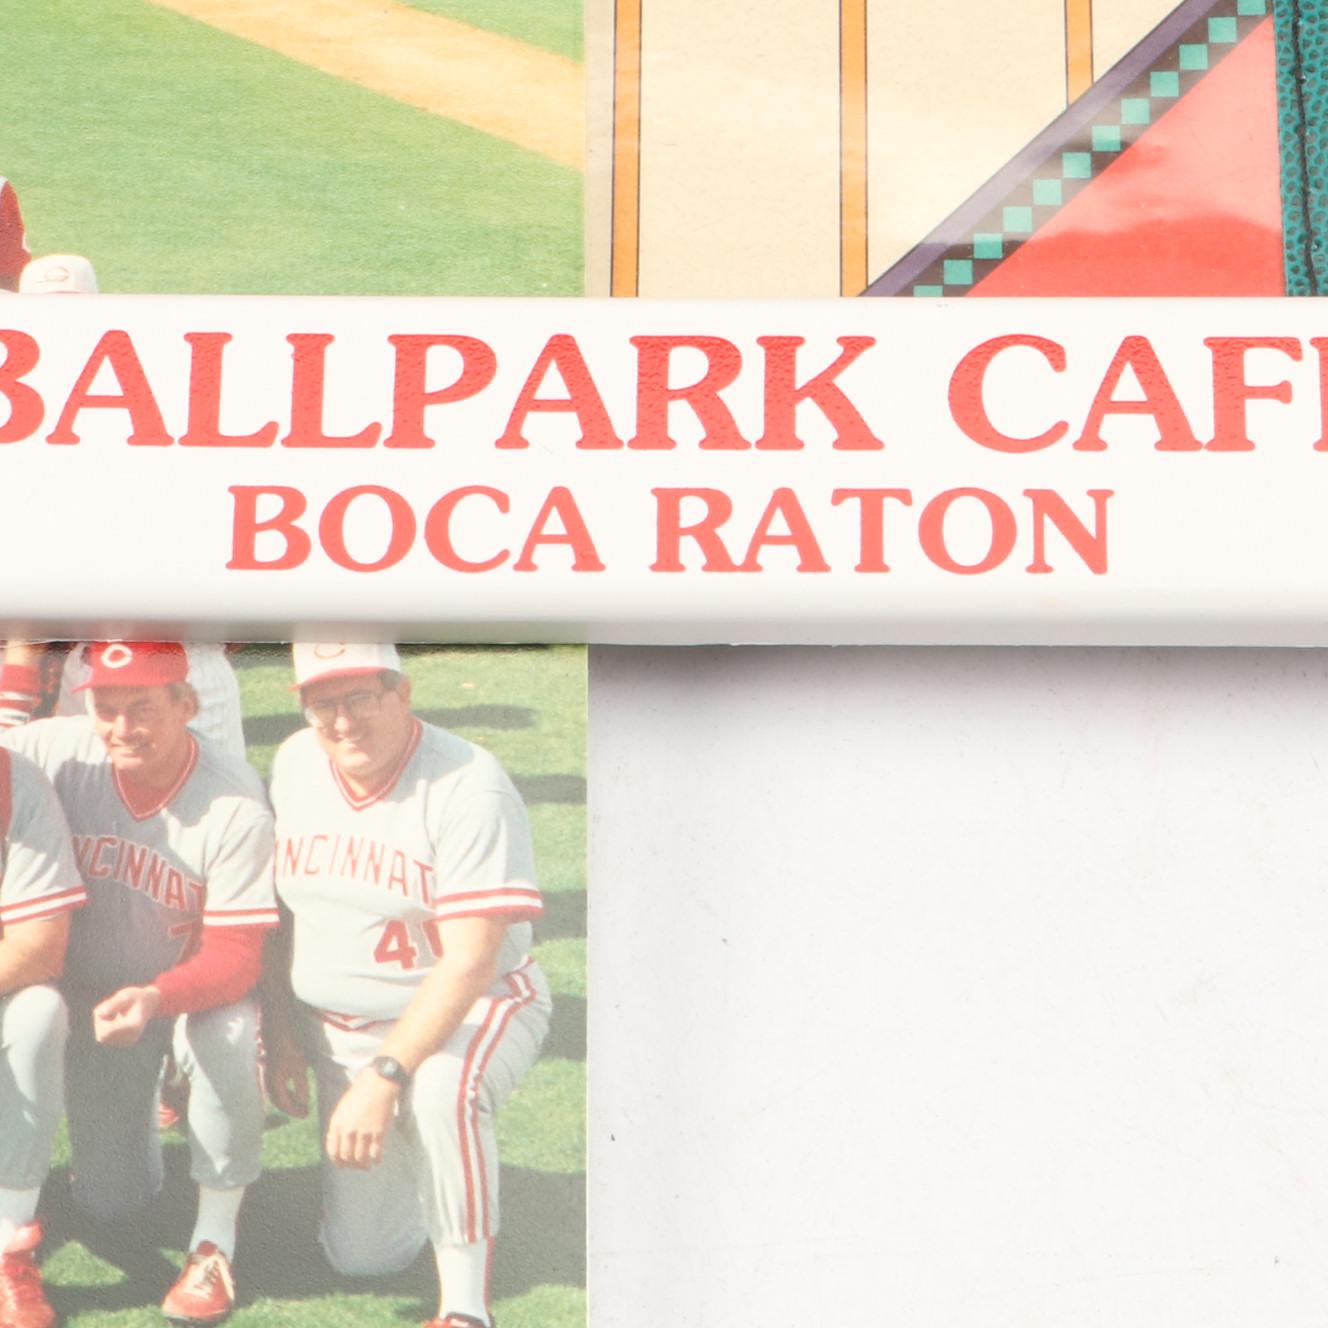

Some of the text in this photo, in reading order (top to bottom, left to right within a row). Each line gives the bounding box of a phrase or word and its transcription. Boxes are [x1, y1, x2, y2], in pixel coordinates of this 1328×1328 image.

[226, 484, 1115, 575] BOCA RATON
[271, 834, 436, 906] INCINNAT
